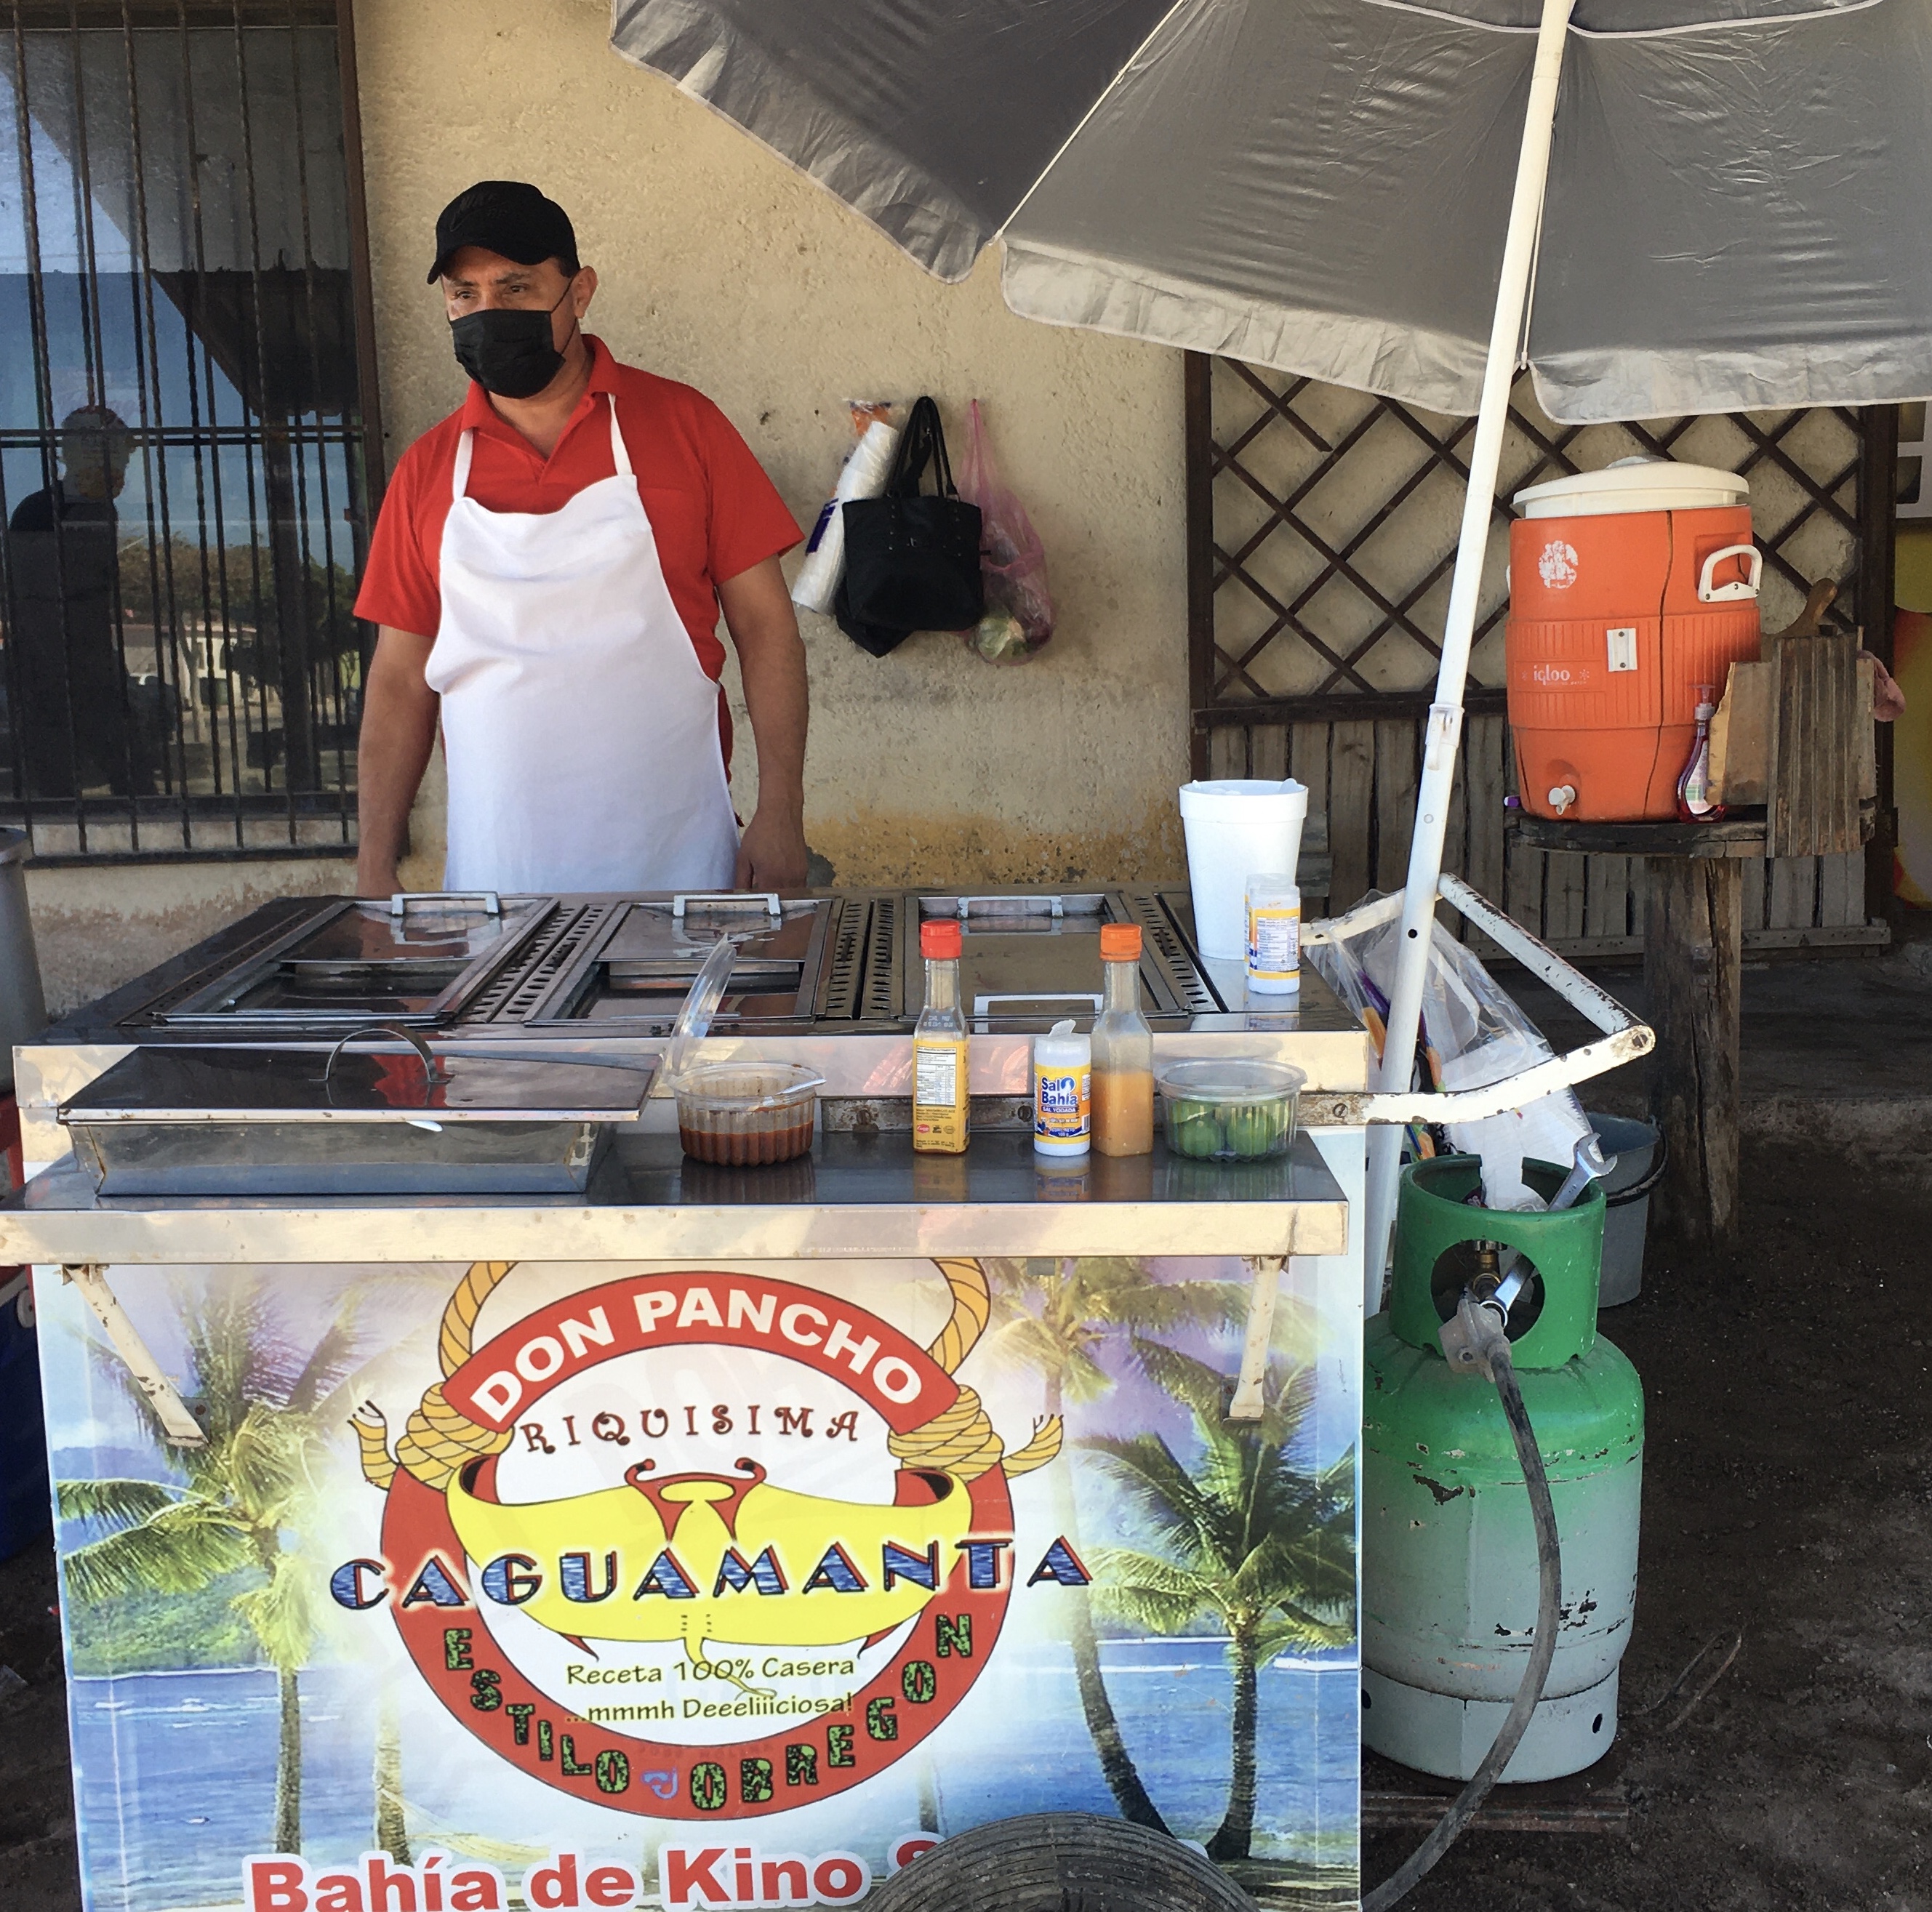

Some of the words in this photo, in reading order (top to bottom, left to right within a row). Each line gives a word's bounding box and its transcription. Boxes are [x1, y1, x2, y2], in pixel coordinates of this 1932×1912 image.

[1534, 664, 1571, 686] igloo
[1041, 1077, 1060, 1091] Sal
[470, 1306, 615, 1423] DON
[633, 1288, 922, 1405] PANCHO
[519, 1405, 859, 1454] RIQUISIMA
[330, 1535, 1095, 1609] CAGUAMANTA
[567, 1664, 662, 1684] Receta
[673, 1658, 755, 1681] 100%
[761, 1658, 854, 1678] Casera
[445, 1628, 630, 1793] ESTILO
[689, 1615, 974, 1809] OBREGON
[683, 1692, 854, 1719] Deeeliiiciosa!
[252, 1857, 498, 1912] Bahía
[530, 1854, 635, 1908] de
[666, 1847, 863, 1903] Kino
